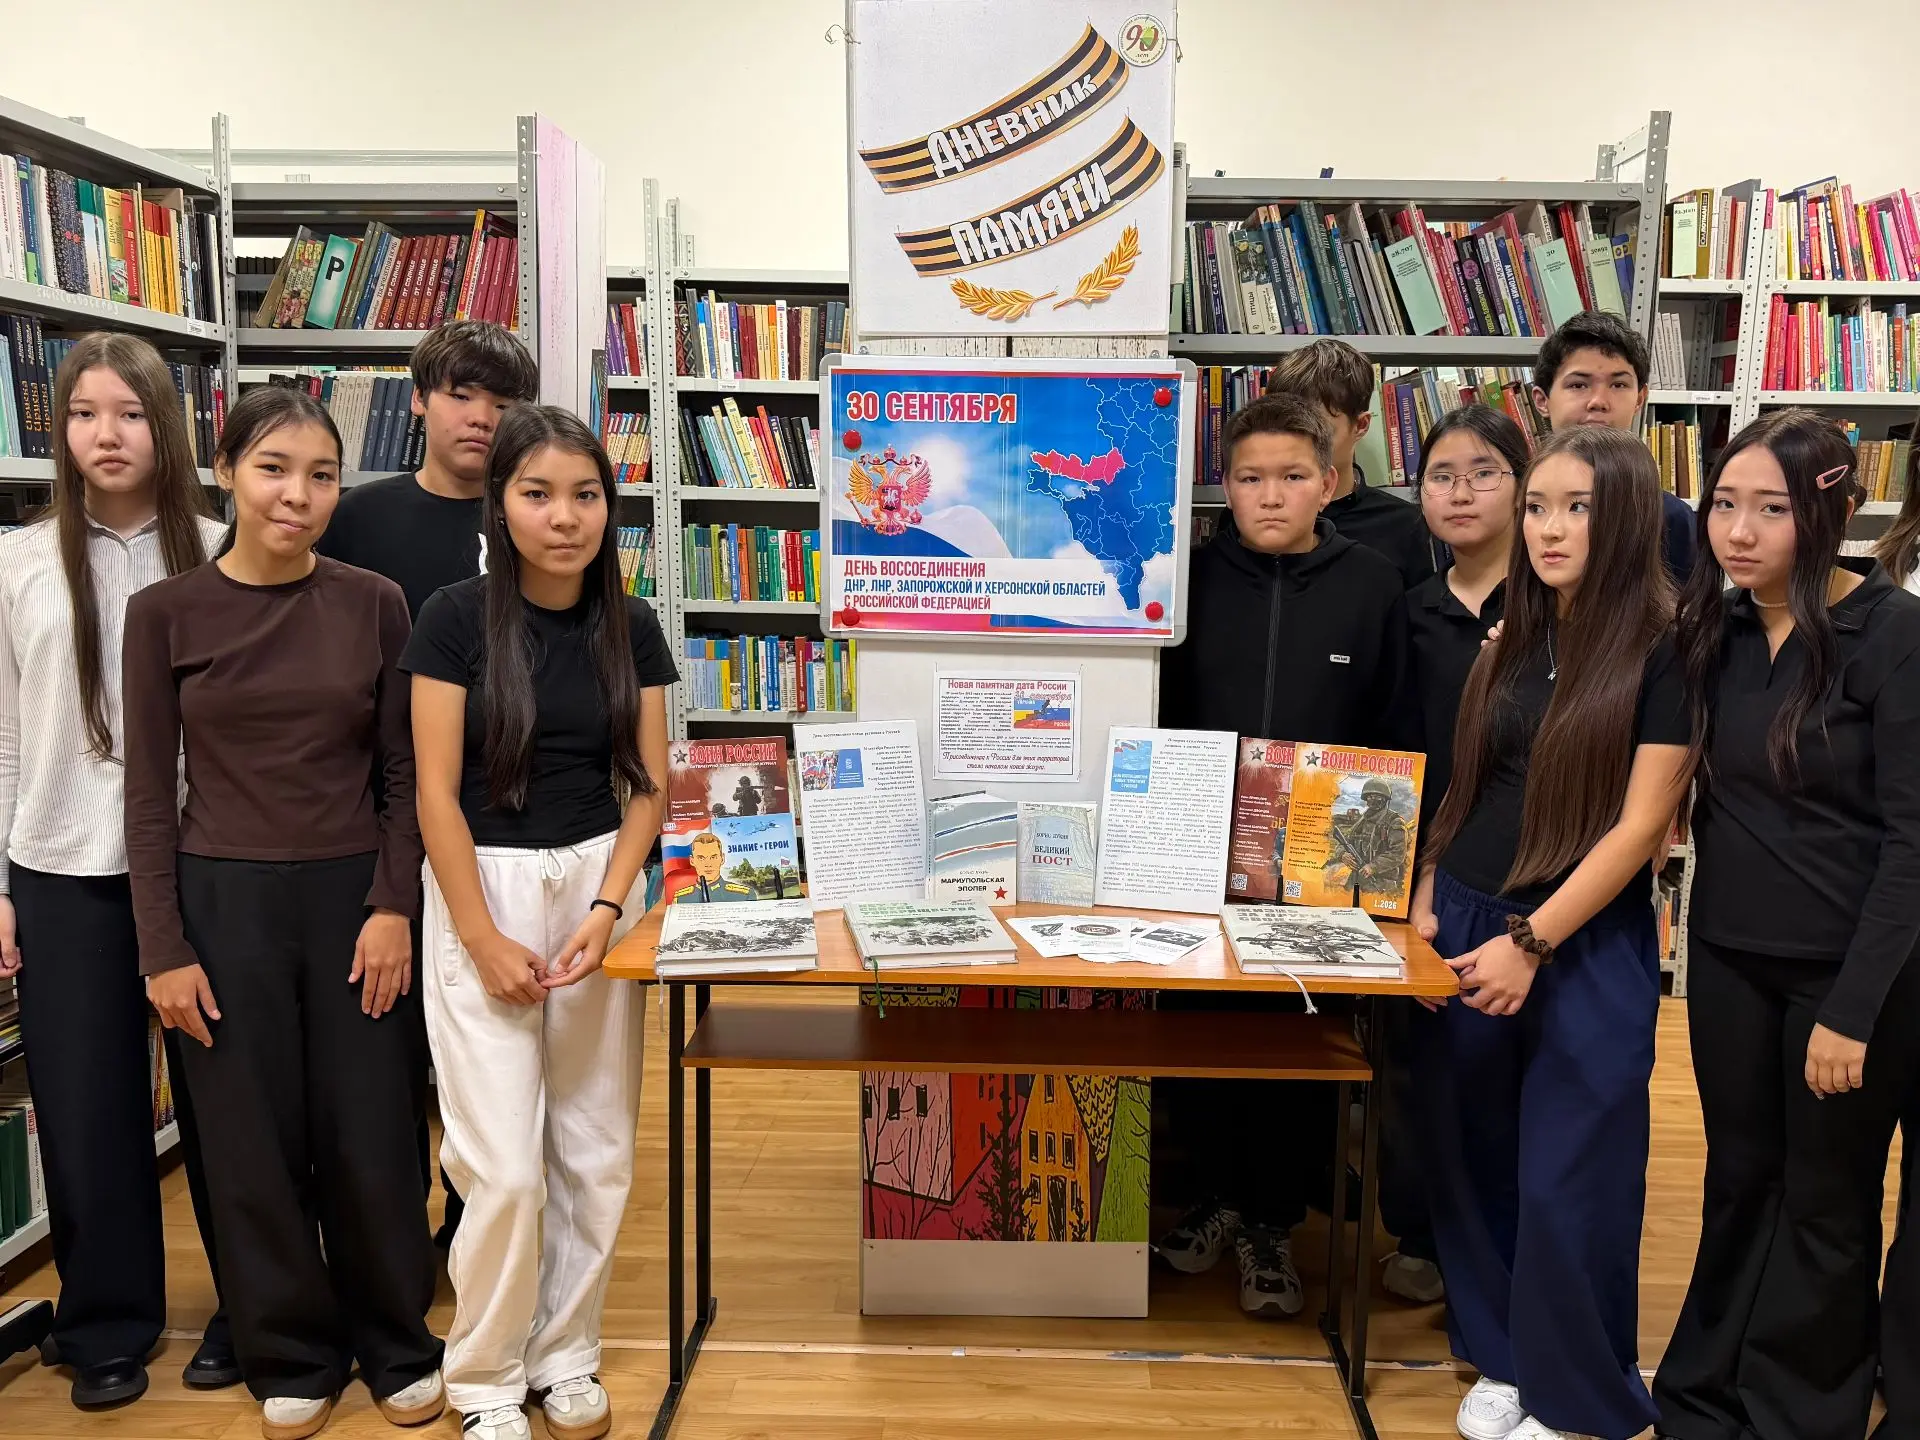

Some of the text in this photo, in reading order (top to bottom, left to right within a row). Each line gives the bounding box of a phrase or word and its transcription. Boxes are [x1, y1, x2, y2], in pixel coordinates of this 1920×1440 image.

[927, 73, 1098, 179] ДНЕВНИК
[949, 162, 1111, 265] ПАМЯТИ
[1504, 264, 1520, 299] АНАТОМИЯ
[1248, 291, 1257, 316] ПТИЦЫ
[847, 391, 1018, 423] 30 СЕНТЯБРЯ
[1392, 426, 1402, 469] КУЛИНАРИЯ
[844, 560, 986, 578] ДЕНЬ ВОССОЕДИНЕНИЯ
[844, 580, 1106, 598] ДНР, ЛНР, ЗАПОРОЖСКОЙ И ХЕРСОНСКОЙ ОБЛАСТЕЙ
[844, 593, 992, 611] С РОССИЙСКОЙ ФЕДЕРАЦИЕЙ
[947, 679, 1067, 691] Новая памятная дата России
[688, 742, 778, 764] ВОИН РОССИИ
[1320, 750, 1358, 770] ВОИН
[1359, 754, 1415, 776] РОССИИ
[727, 839, 790, 854] ЗНАНИЕ ГЕРОИ
[1034, 846, 1071, 856] ВЕЛИКИЙ
[1032, 854, 1073, 866] ПОСТ
[941, 876, 1006, 884] МАРИУПОЛЬСКАЯ
